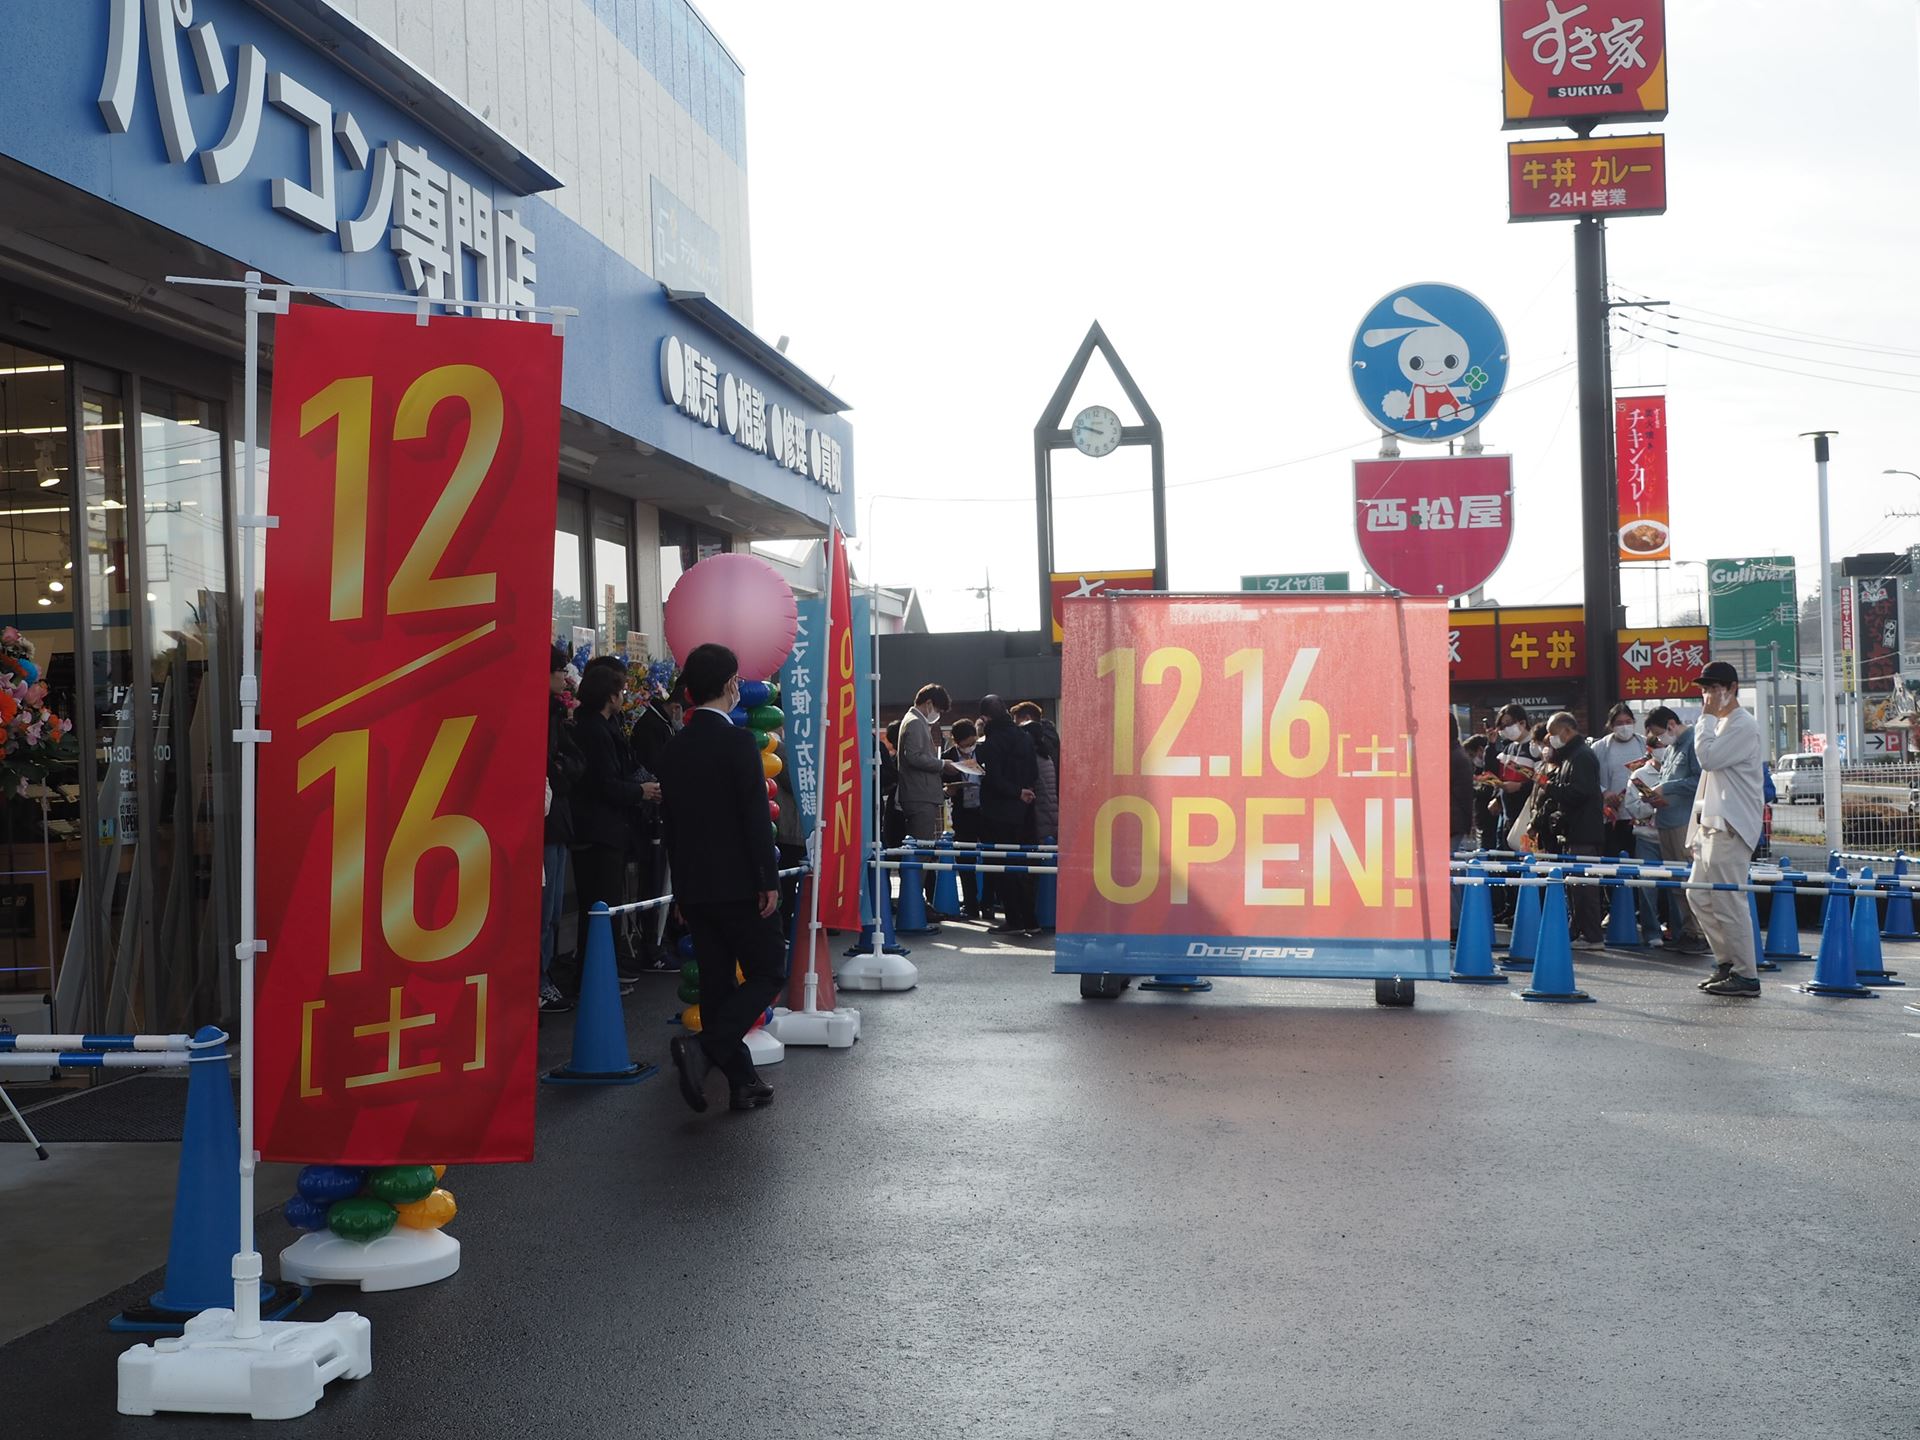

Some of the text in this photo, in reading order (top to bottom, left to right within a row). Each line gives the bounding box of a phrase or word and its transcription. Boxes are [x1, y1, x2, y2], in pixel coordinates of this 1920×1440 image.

[1522, 0, 1646, 81] すき家
[1557, 84, 1613, 98] SUKIYA
[98, 0, 537, 322] パソコン専門店
[1522, 155, 1652, 189] 牛丼 カレー
[1549, 189, 1627, 208] 24H 営業
[681, 343, 719, 429] 販売
[736, 378, 768, 455] 相談
[1626, 408, 1646, 518] チキンカレー
[296, 362, 506, 622] 12
[1365, 495, 1503, 532] 西松屋
[1265, 576, 1326, 591] タイヤ館
[1711, 566, 1793, 586] Gulliver
[1510, 629, 1576, 670] 牛丼
[1631, 648, 1649, 663] IN
[1653, 636, 1706, 671] すき家
[1095, 646, 1413, 779] 12.16 [土]
[1511, 696, 1549, 706] SUKIYA
[1887, 734, 1900, 751] P
[832, 626, 855, 908] OPEN!
[296, 714, 493, 978] 16
[1092, 794, 1415, 909] OPEN!
